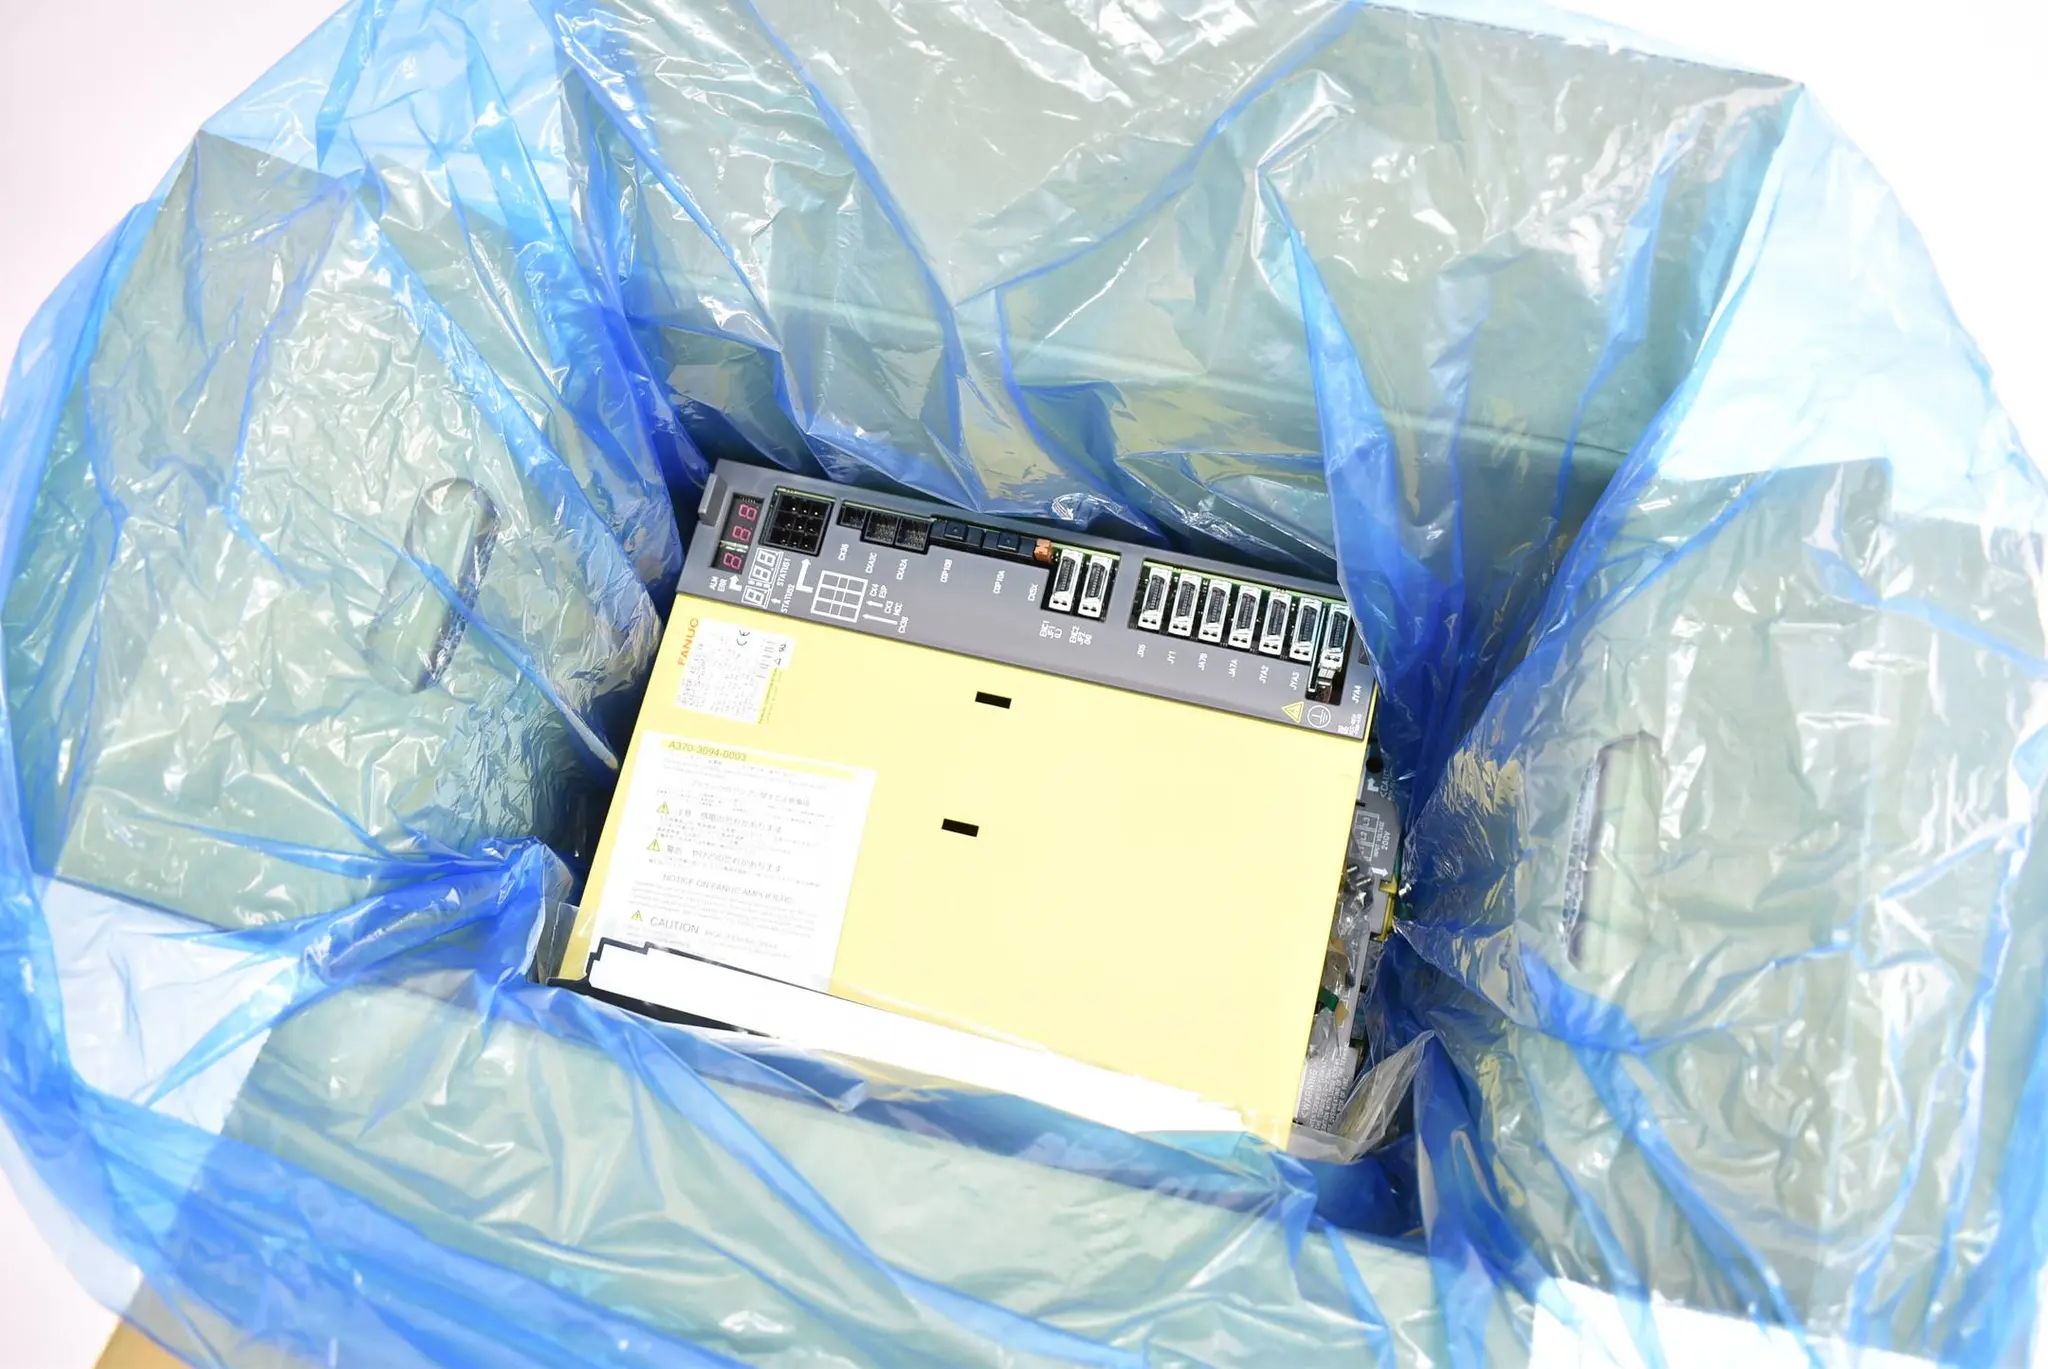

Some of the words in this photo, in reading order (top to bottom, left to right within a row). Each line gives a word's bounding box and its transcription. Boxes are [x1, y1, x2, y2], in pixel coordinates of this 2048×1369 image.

[776, 558, 790, 587] STATUS1
[709, 575, 719, 590] ALM
[718, 578, 728, 593] ERR
[780, 584, 795, 613] STATUS2
[677, 618, 699, 666] FANUC
[1167, 650, 1177, 665] JY1
[1259, 665, 1270, 684] JYA2
[1352, 685, 1362, 704] JYA4
[669, 740, 748, 762] A370-3094-0003
[1363, 817, 1371, 828] L3
[1360, 831, 1368, 841] L2
[1381, 830, 1391, 851] 200V
[650, 916, 700, 935] CAUTION
